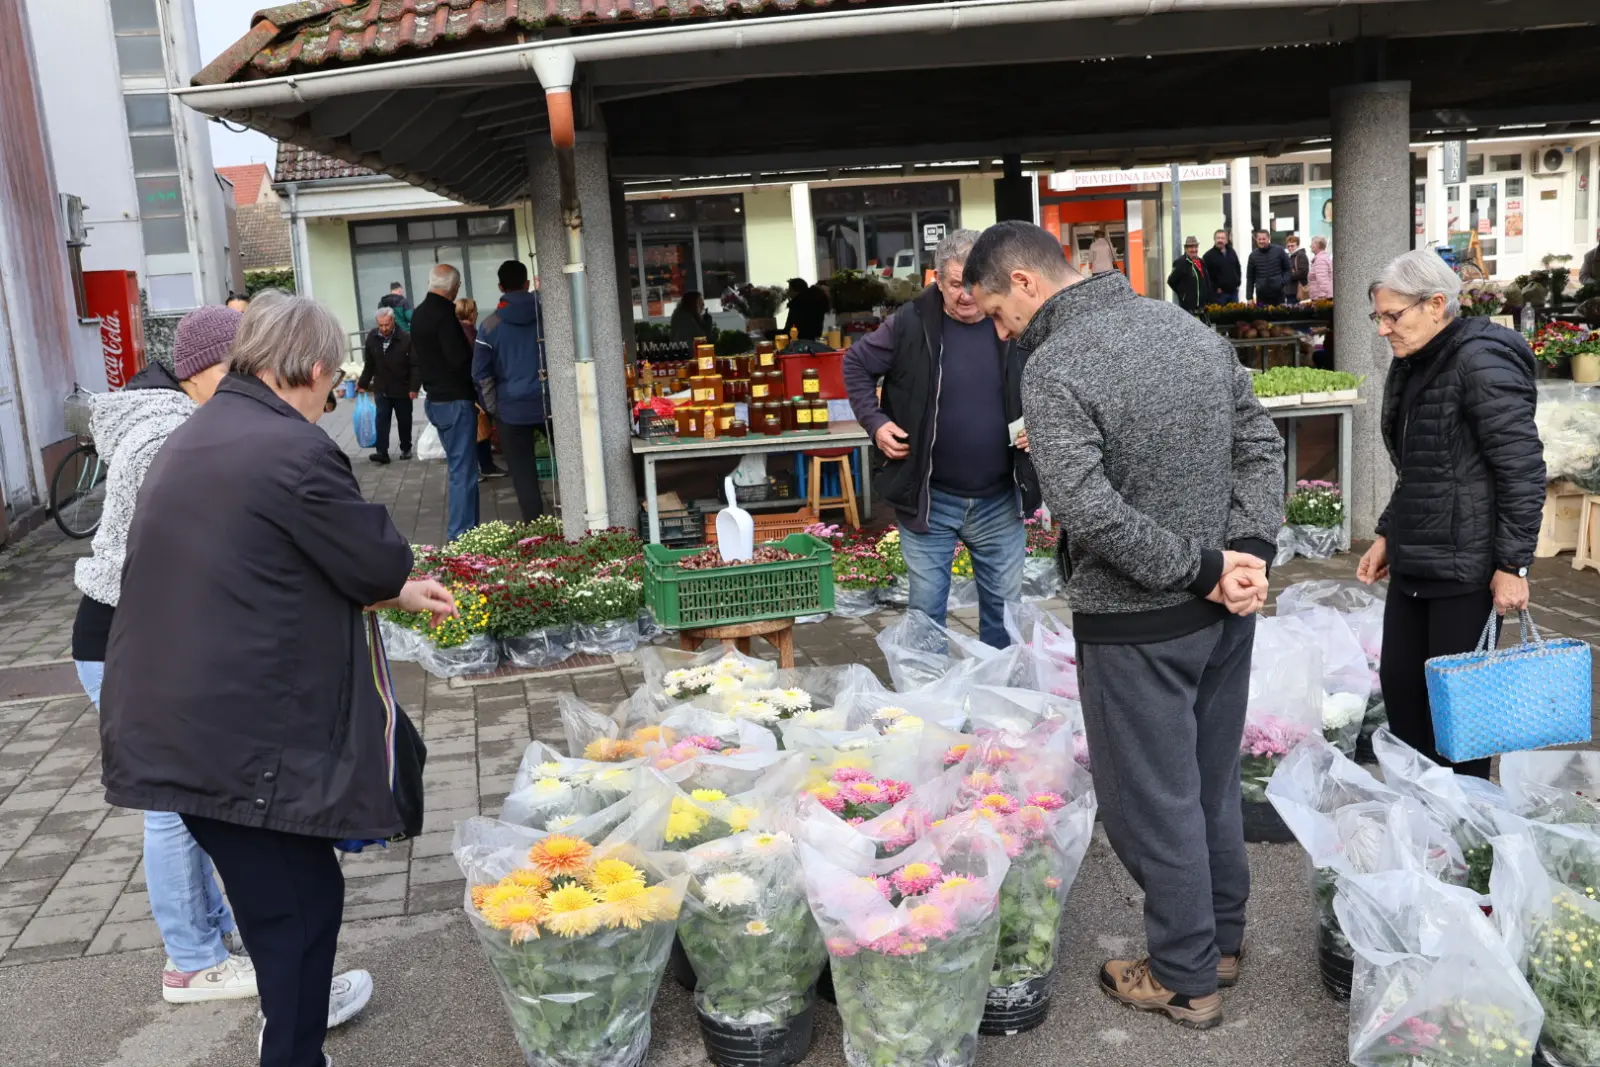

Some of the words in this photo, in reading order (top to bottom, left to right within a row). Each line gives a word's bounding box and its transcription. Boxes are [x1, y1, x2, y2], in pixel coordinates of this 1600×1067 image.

[1076, 171, 1139, 185] PRIVREDNA
[1143, 169, 1172, 180] BANK
[1183, 167, 1224, 178] ZAGREB
[97, 312, 123, 392] oca-Cola
